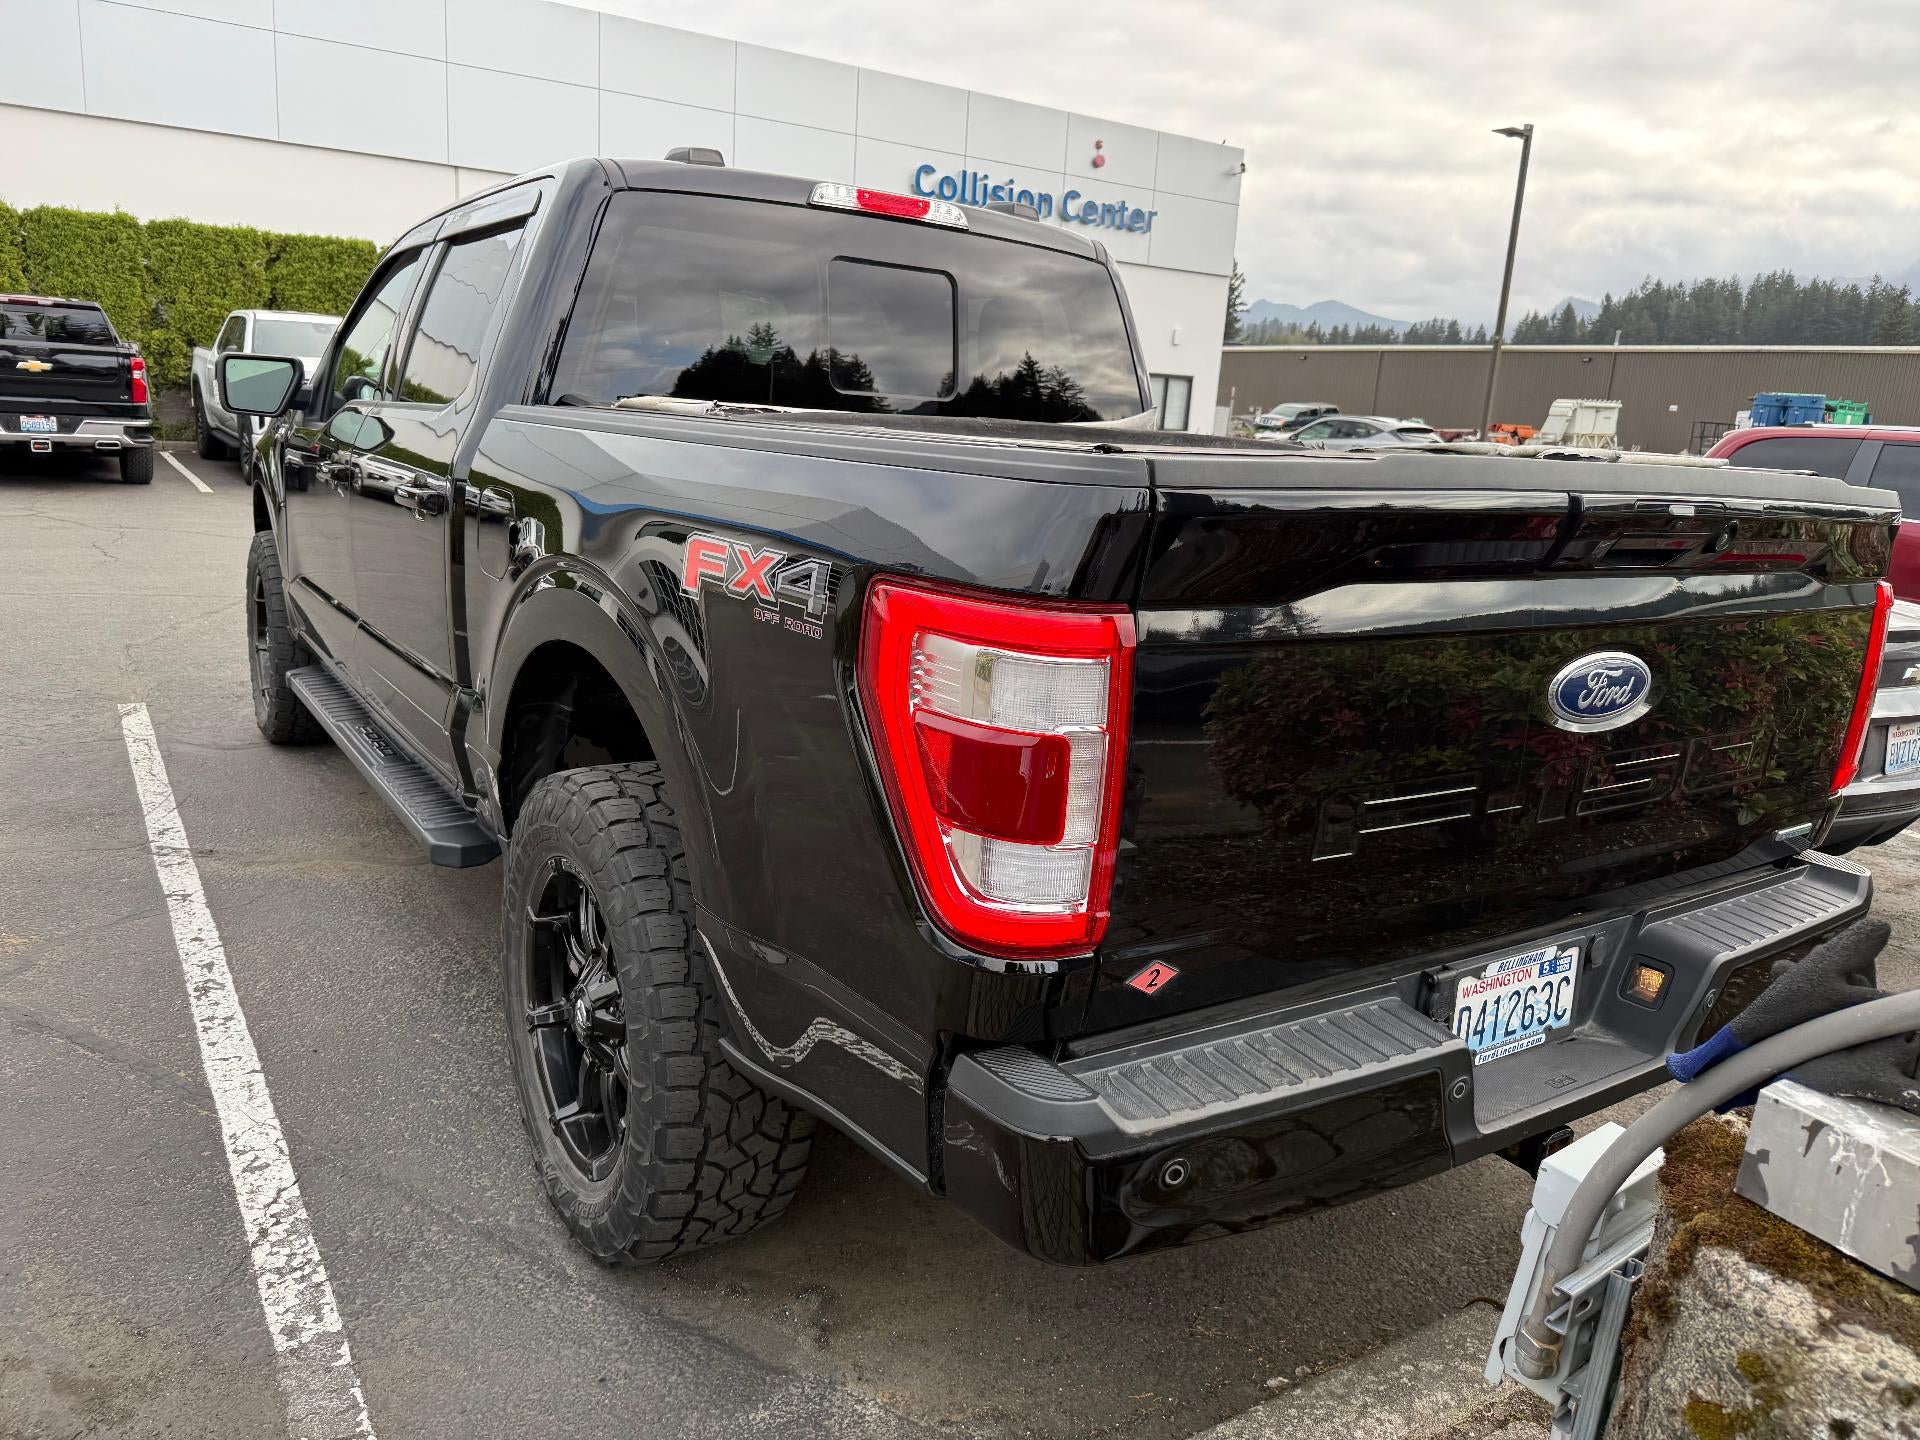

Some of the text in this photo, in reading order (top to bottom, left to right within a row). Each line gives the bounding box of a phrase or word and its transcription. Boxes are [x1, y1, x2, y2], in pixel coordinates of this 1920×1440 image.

[914, 164, 1157, 232] Collision Center
[679, 531, 832, 624] FX4
[754, 608, 823, 639] OFF ROAD
[1578, 669, 1635, 709] Ford
[356, 724, 396, 758] FORD
[1497, 950, 1547, 973] BELLINGHAM
[1145, 968, 1161, 989] 2
[1462, 967, 1533, 999] WASHINGTON
[1478, 1037, 1543, 1064] FordLincoln.com
